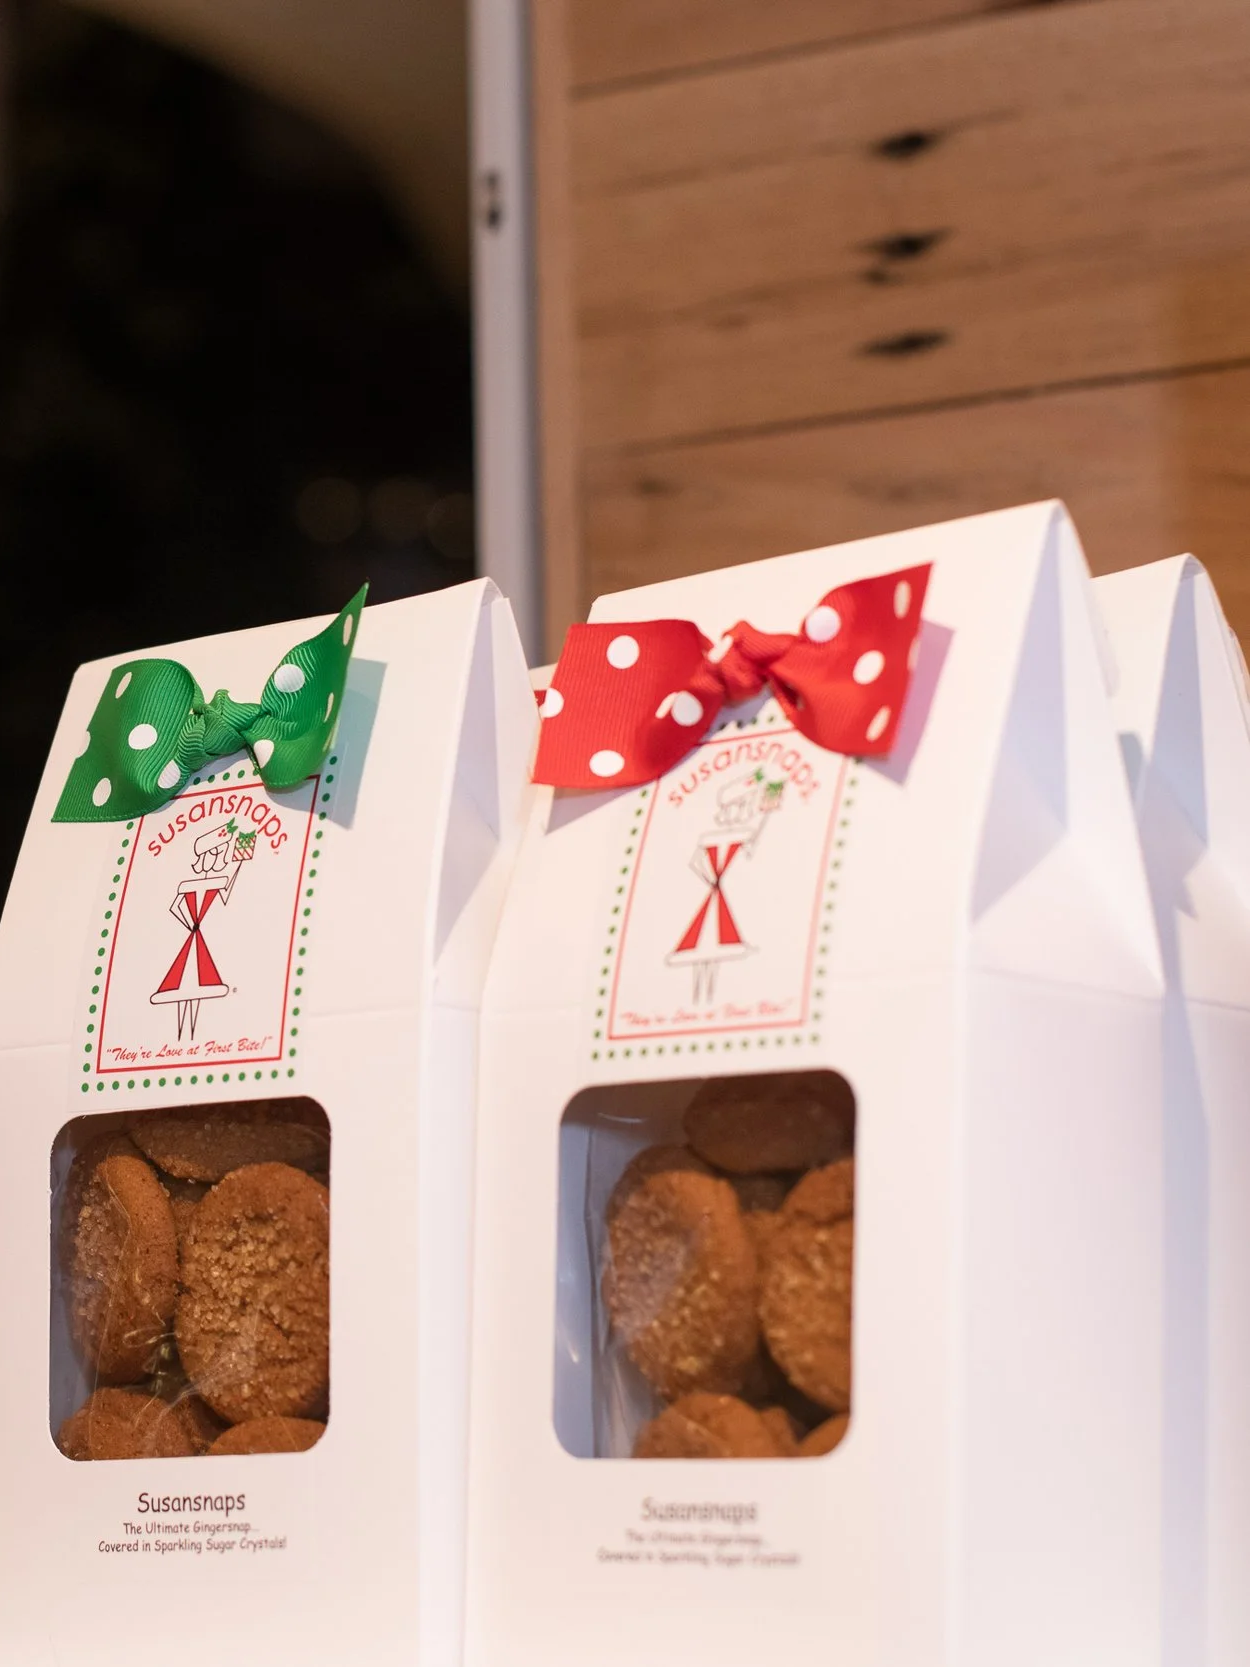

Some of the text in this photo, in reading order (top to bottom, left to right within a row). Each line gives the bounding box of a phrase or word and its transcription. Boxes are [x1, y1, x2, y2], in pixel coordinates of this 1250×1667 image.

[148, 794, 288, 857] susansnaps
[156, 1044, 182, 1058] Love
[187, 1045, 199, 1056] at
[205, 1040, 233, 1056] First
[137, 1492, 246, 1517] Susansnaps
[123, 1523, 142, 1535] The
[146, 1522, 190, 1534] Ultimate
[98, 1535, 287, 1555] Covered in Sparkling Sugar Crystals!
